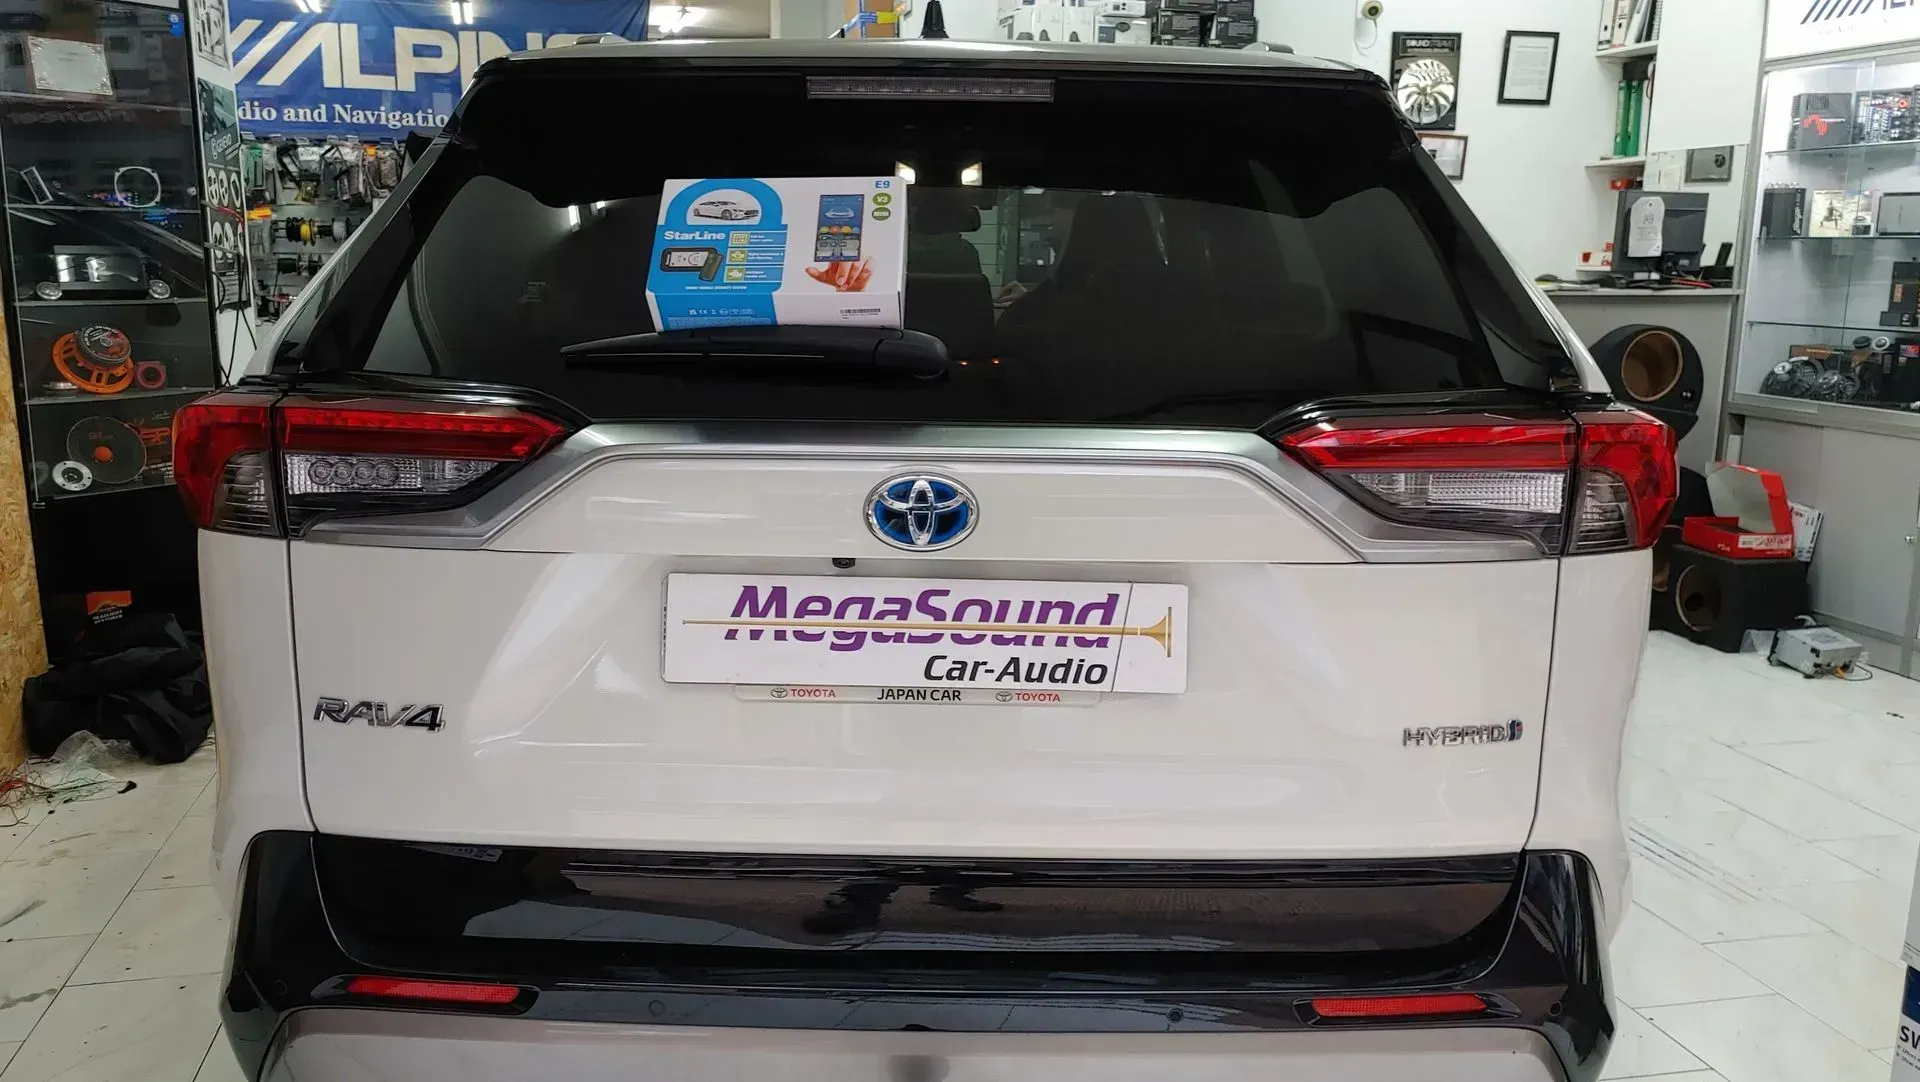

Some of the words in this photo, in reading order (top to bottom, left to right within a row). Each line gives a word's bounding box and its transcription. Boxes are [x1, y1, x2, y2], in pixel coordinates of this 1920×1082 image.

[256, 22, 578, 95] ALPI
[283, 104, 328, 123] and
[875, 180, 890, 189] E9
[663, 230, 726, 240] StarLine
[724, 584, 1120, 650] MegaSound
[923, 654, 1109, 685] Car-Audio
[790, 688, 836, 699] TOYOTA
[877, 688, 930, 701] JAPAN
[930, 689, 962, 702] CAR
[1015, 691, 1061, 703] TOYOTA
[313, 697, 446, 732] RAV4
[1403, 725, 1506, 746] HYBRID
